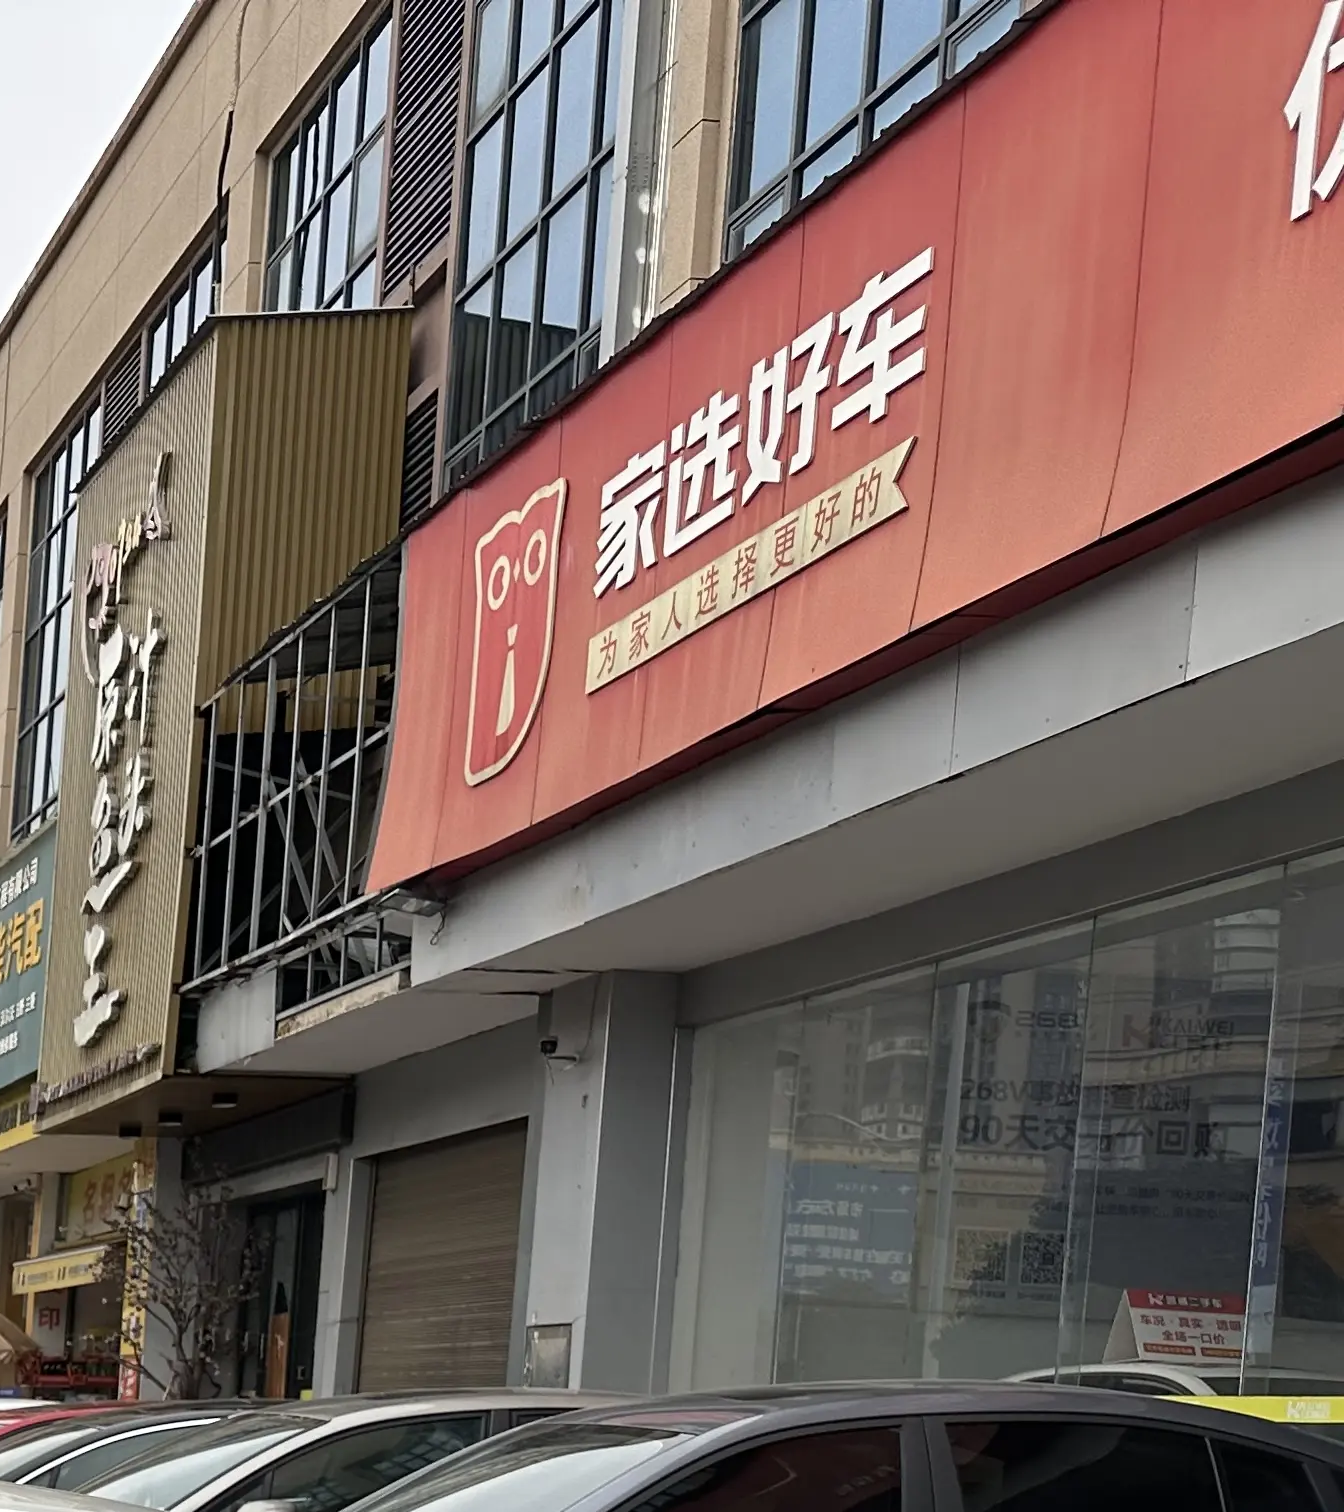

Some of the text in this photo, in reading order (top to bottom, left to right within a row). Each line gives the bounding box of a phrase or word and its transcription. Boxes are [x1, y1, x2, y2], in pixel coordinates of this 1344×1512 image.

[590, 246, 937, 598] 家选好车
[597, 467, 884, 678] 为家人选择更好的
[38, 1307, 61, 1332] 印
[1162, 1330, 1225, 1345] 全场一口价
